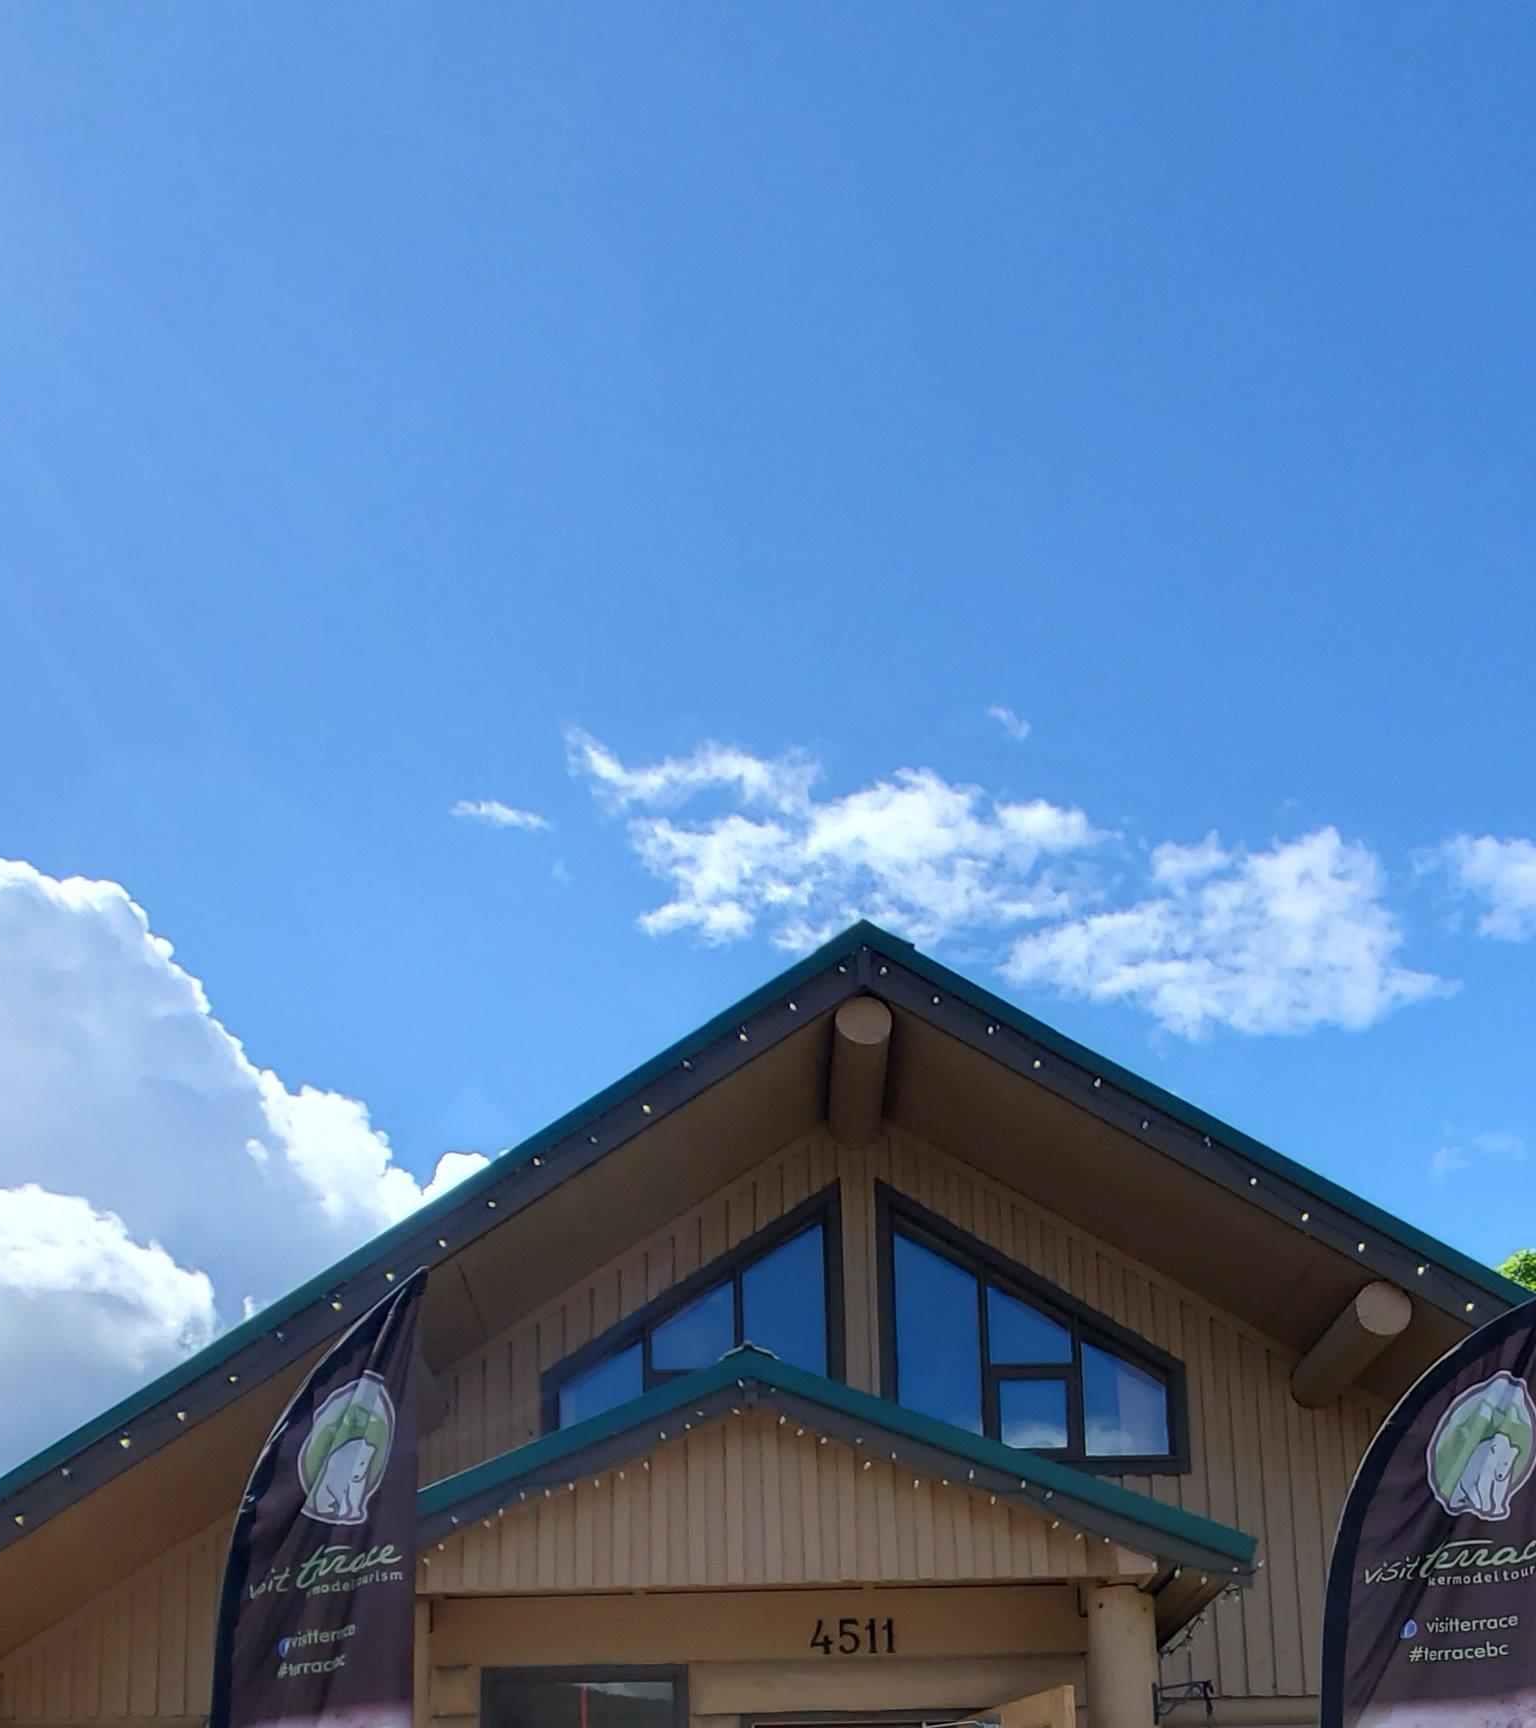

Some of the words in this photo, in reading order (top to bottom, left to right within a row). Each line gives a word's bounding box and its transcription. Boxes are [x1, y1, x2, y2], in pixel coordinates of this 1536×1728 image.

[1364, 1554, 1421, 1585] visit
[809, 1616, 897, 1655] 4511
[1425, 1614, 1519, 1635] visitterrace
[1408, 1641, 1509, 1663] #terracebc
